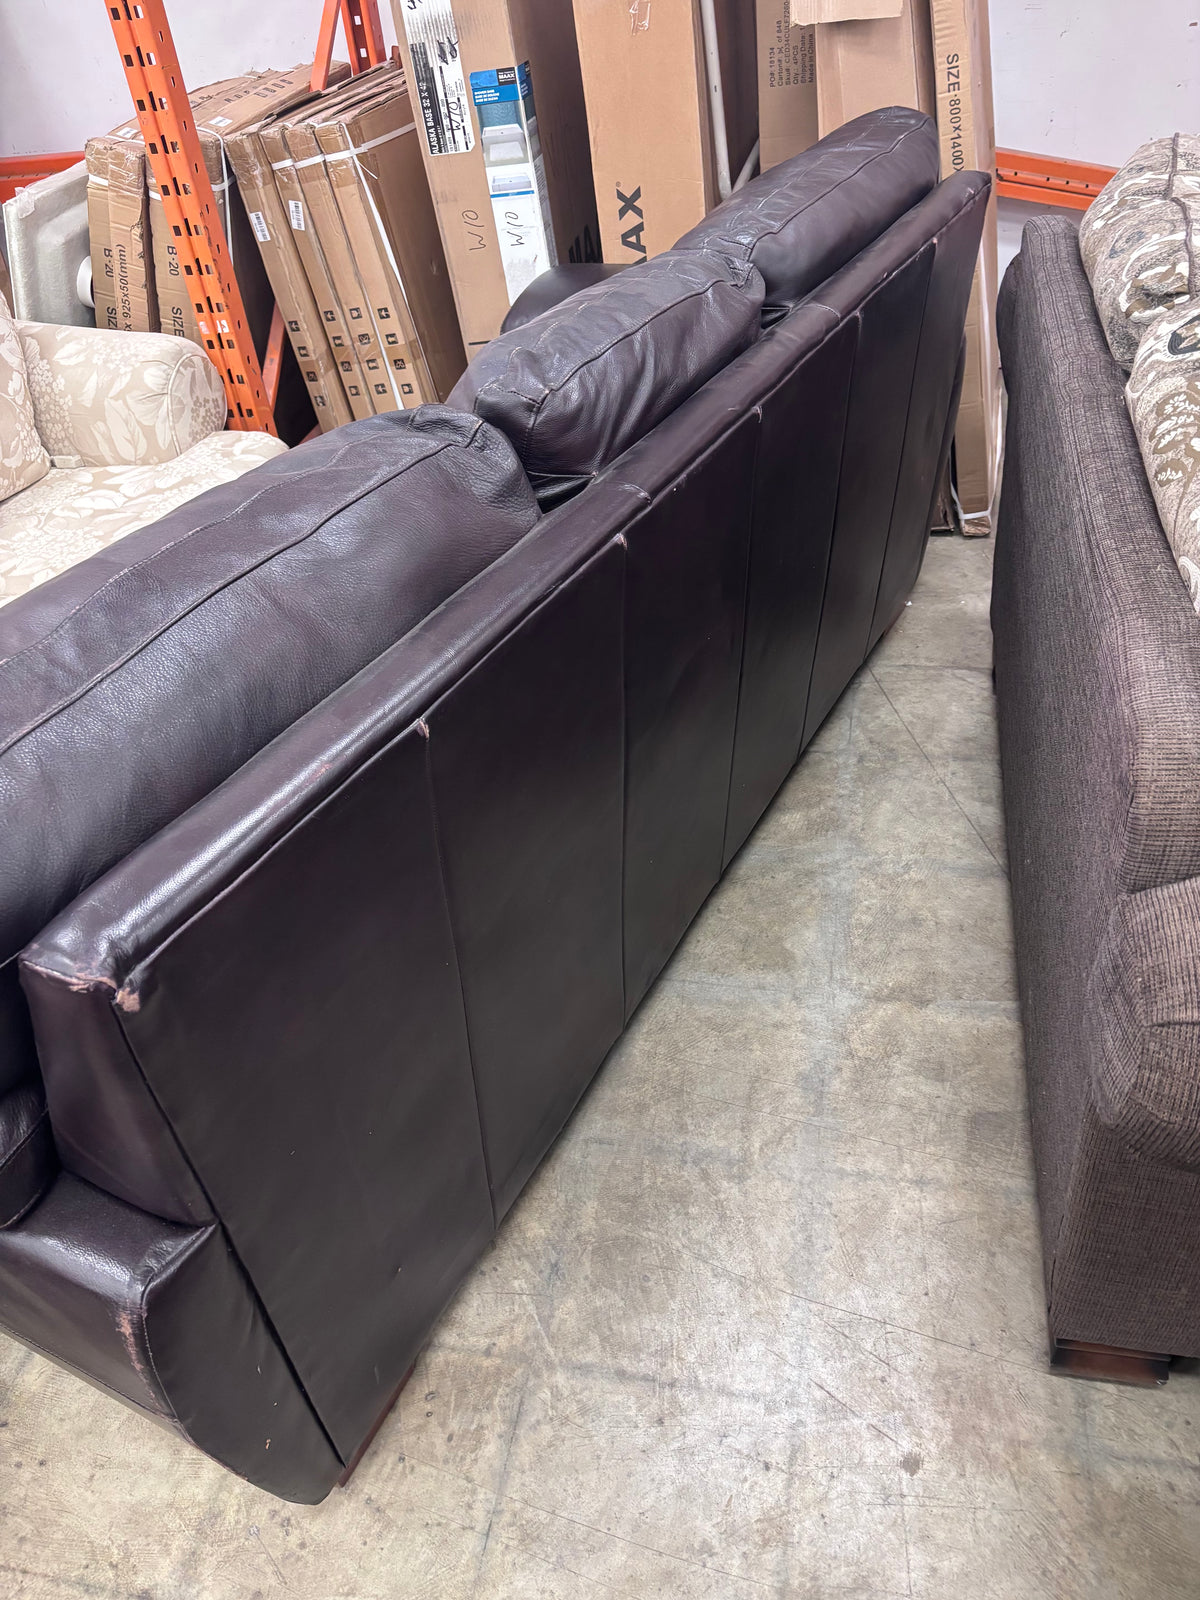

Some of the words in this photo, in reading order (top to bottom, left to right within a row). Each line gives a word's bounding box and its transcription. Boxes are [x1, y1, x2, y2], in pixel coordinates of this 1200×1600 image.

[423, 99, 431, 108] 32
[425, 108, 434, 126] BASE
[428, 128, 440, 154] ALASKA
[616, 184, 648, 265] AX
[106, 306, 118, 330] SIZ
